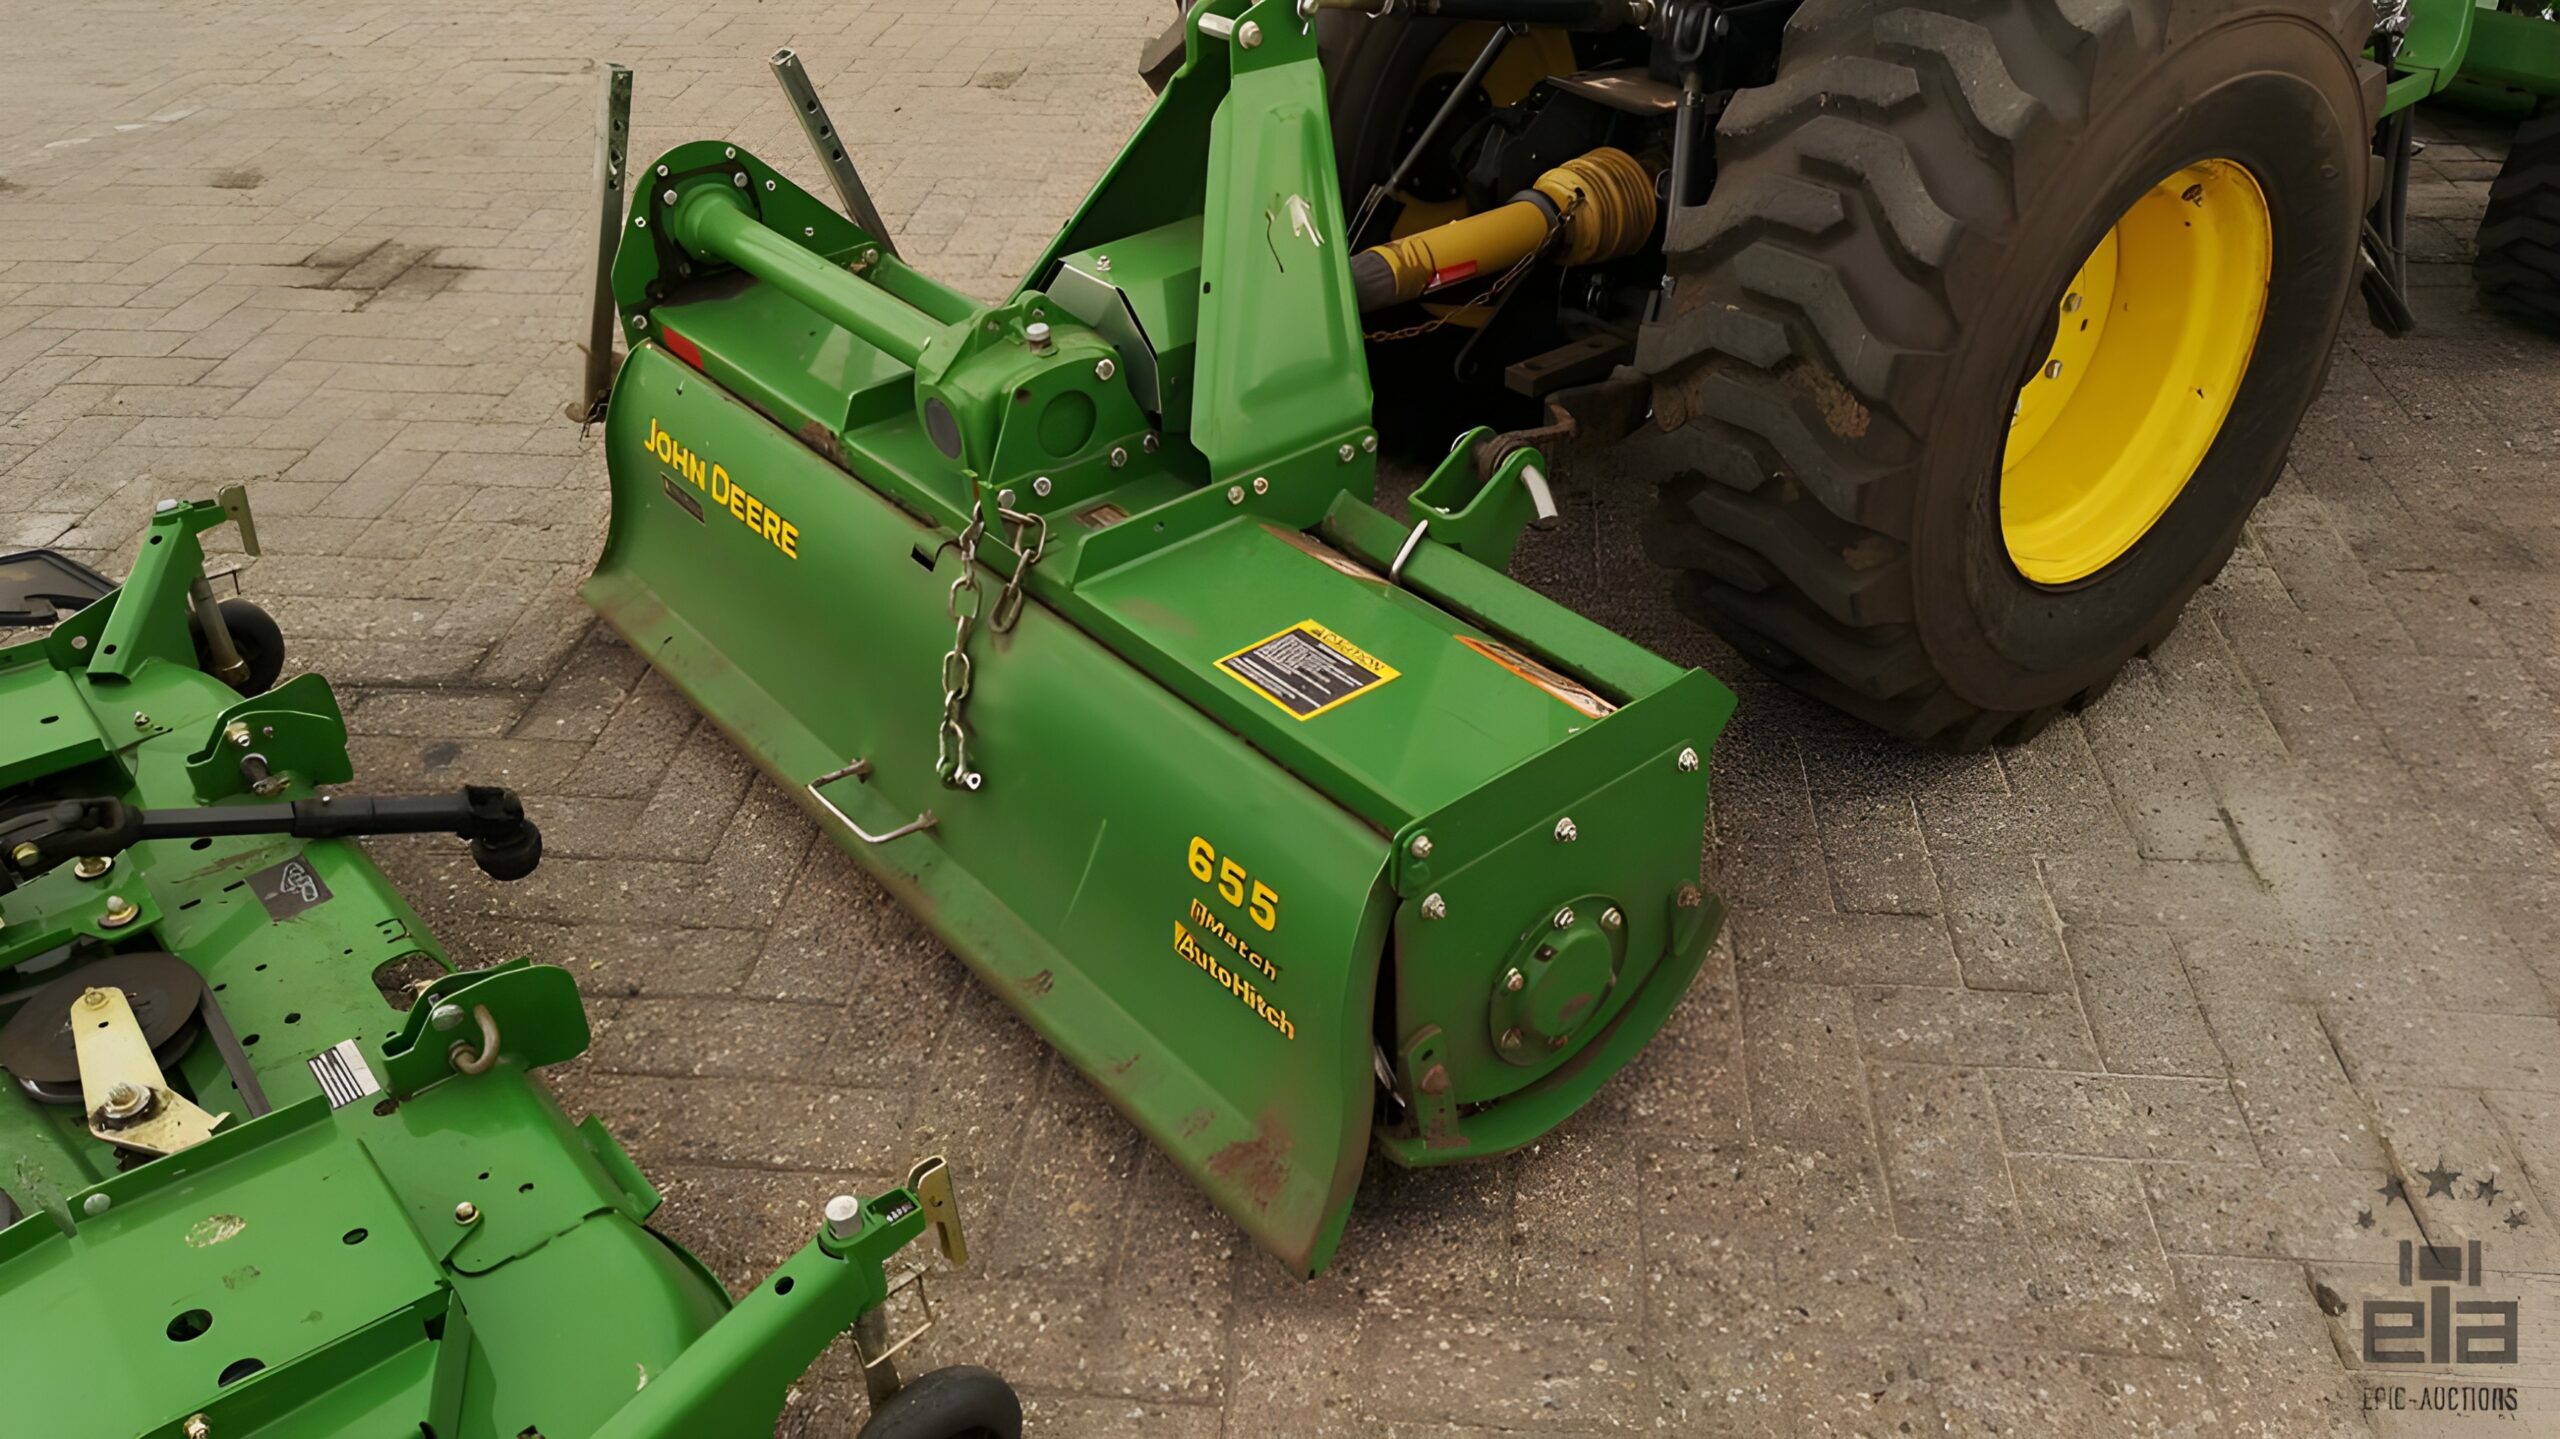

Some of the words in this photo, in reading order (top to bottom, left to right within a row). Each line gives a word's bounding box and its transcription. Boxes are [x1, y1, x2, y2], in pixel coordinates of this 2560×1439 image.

[644, 417, 705, 491] JOHN
[711, 463, 799, 560] DEERE
[1188, 836, 1279, 932] 655
